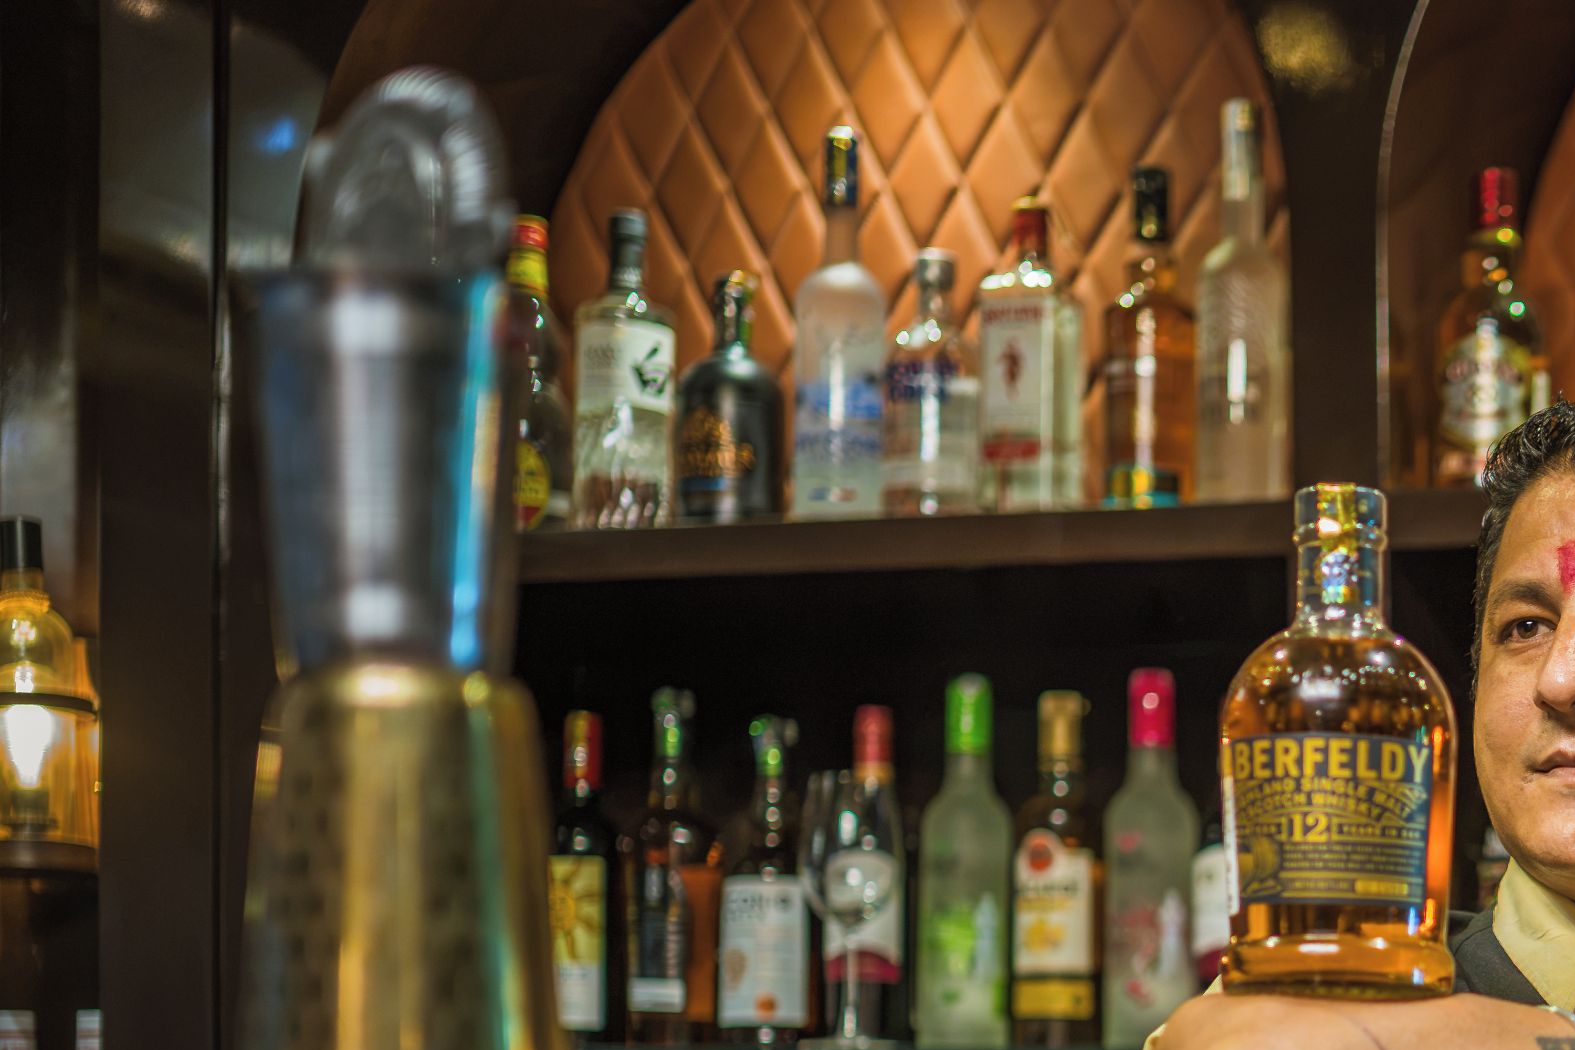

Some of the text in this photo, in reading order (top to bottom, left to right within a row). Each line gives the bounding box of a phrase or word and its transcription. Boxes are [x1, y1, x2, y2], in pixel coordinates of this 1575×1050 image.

[1300, 776, 1368, 798] SINGLE
[1372, 790, 1413, 818] MALT
[1310, 792, 1383, 823] WHISKY
[1291, 813, 1329, 843] 12
